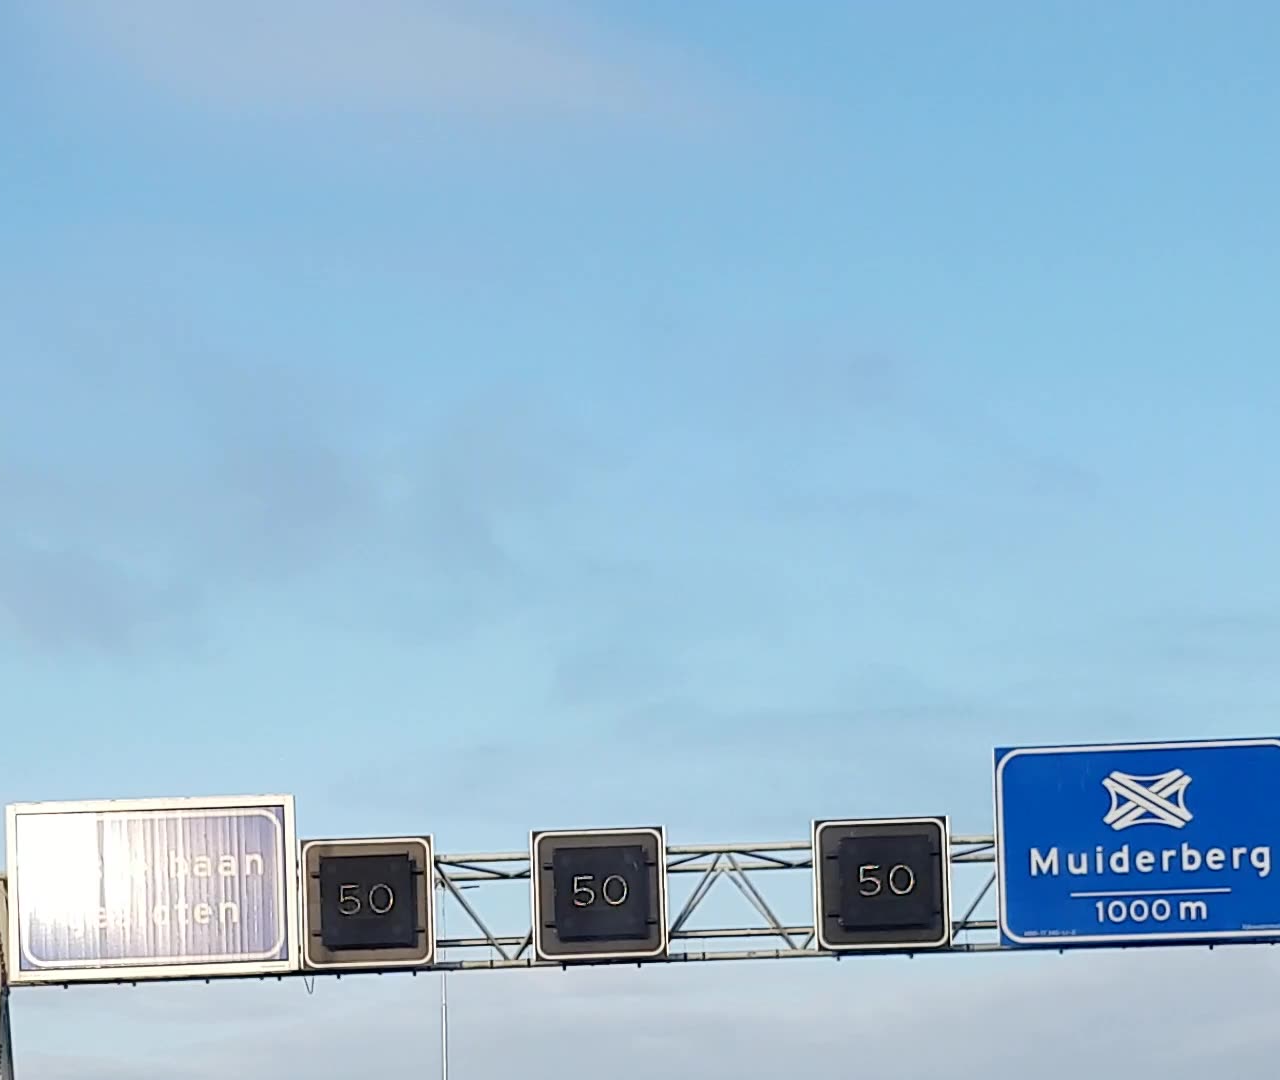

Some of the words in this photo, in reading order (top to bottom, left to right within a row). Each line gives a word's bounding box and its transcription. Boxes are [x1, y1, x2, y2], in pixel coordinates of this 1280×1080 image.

[1029, 842, 1272, 878] Muiderberg
[572, 874, 628, 906] 50
[859, 864, 915, 896] 50
[338, 883, 394, 916] 50
[1095, 899, 1171, 923] 1000
[1179, 900, 1208, 921] m
